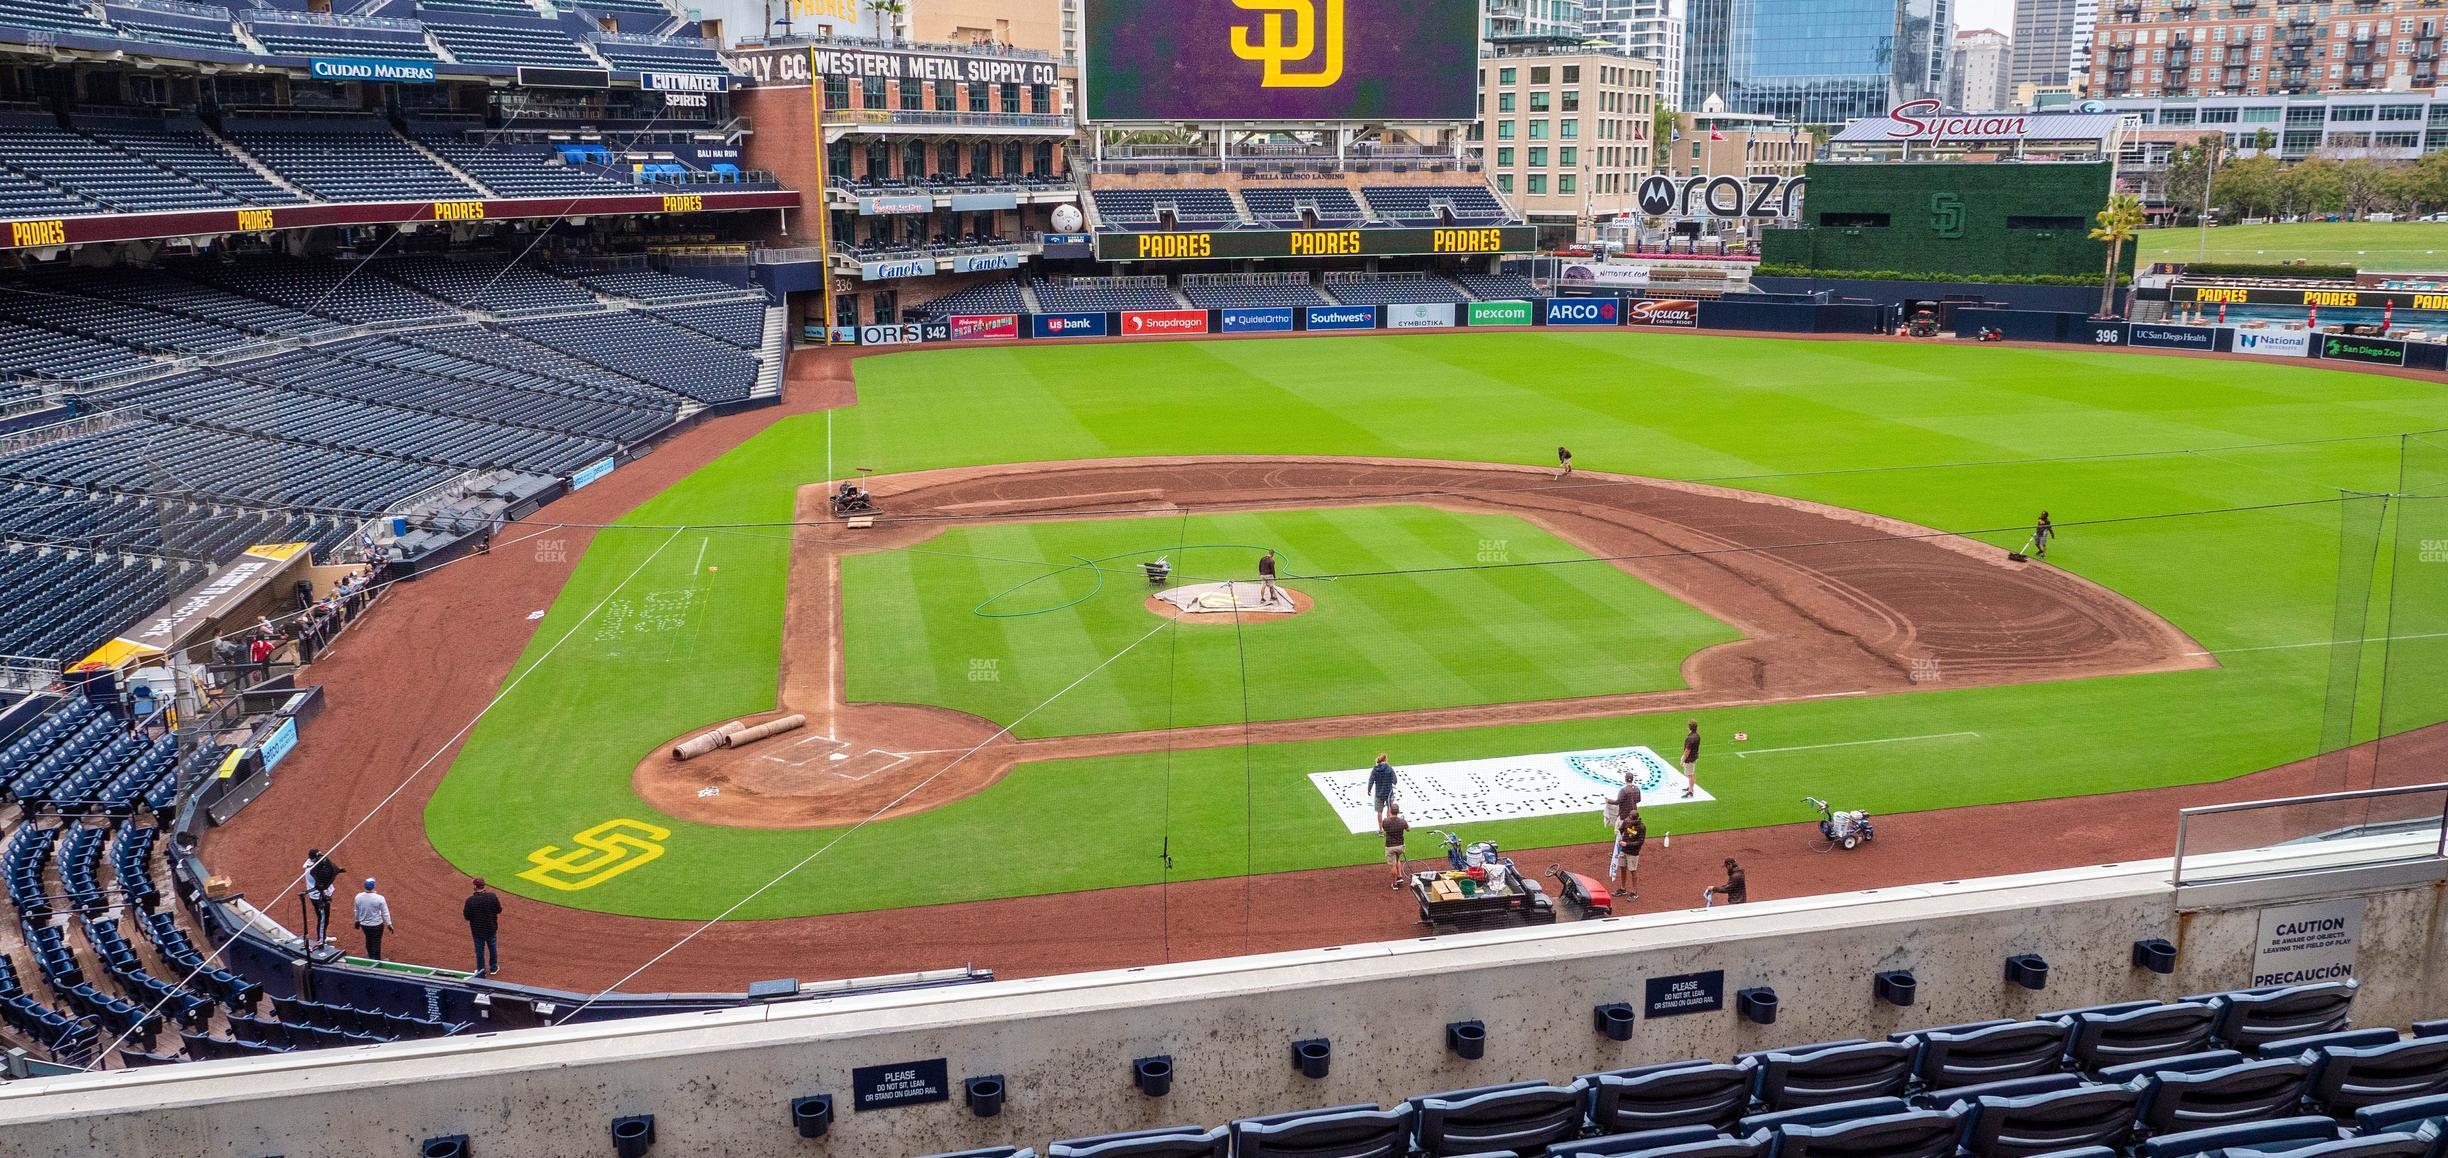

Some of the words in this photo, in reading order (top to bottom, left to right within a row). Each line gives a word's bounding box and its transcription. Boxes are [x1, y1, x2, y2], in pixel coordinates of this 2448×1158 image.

[315, 61, 371, 77] CIUDAD
[375, 64, 433, 79] MADERAS
[779, 54, 812, 80] CO.
[814, 50, 900, 78] WESTERN
[908, 56, 964, 81] METAL
[967, 60, 1027, 84] SUPPLY
[1032, 64, 1058, 85] CO.
[651, 73, 720, 91] CUTWATER
[665, 93, 707, 107] SPIRITS
[1886, 99, 2029, 149] Sycuan
[697, 149, 711, 158] BALI
[724, 149, 738, 158] RUM
[434, 202, 484, 220] PADRES
[663, 195, 702, 212] PADRES
[238, 209, 273, 230] PADRES
[12, 220, 66, 247] PADRES
[1433, 229, 1501, 252] PADRES
[1139, 233, 1211, 258] PADRES
[1291, 231, 1360, 255] PADRES
[878, 261, 923, 278] Canel's
[967, 255, 1008, 271] Canel's
[836, 278, 852, 292] 336
[2303, 291, 2357, 306] PADRES
[1311, 313, 1364, 323] Southwest
[1549, 304, 1598, 319] ARCO
[1632, 301, 1691, 324] Sycuan
[1050, 319, 1062, 329] us
[1064, 318, 1091, 329] bank
[1147, 318, 1202, 329] Snapdragon
[1238, 315, 1289, 325] QuidelOrtho
[926, 326, 946, 339] 342
[2095, 329, 2118, 343] 396
[2137, 330, 2149, 339] UC
[2149, 331, 2162, 340] San
[2163, 332, 2183, 342] Diego
[2183, 333, 2207, 342] Health
[2260, 335, 2304, 346] National
[2343, 344, 2359, 353] San
[2359, 346, 2382, 356] Diego
[2384, 348, 2401, 357] Zoo
[2276, 917, 2344, 936] CAUTION
[2316, 932, 2345, 940] OBJECTS
[2263, 945, 2291, 954] LEAVING
[2306, 941, 2324, 949] FIELD
[2335, 938, 2351, 946] PLAY
[2255, 962, 2352, 987] PRECAUCIÓN
[1672, 981, 1698, 992] PLEASE
[1654, 1002, 1661, 1010] OR
[1662, 1000, 1678, 1009] STAND
[1678, 999, 1686, 1007] ON
[1686, 997, 1703, 1006] GUARD
[1672, 992, 1682, 1000] NOT
[885, 1070, 916, 1082] PLEASE
[874, 1092, 893, 1100] STAND
[904, 1088, 924, 1097] GUARD
[925, 1086, 937, 1095] RAIL
[877, 1084, 885, 1092] DO
[886, 1082, 898, 1090] NOT
[899, 1081, 909, 1089] SIT,
[910, 1080, 925, 1088] LEAN
